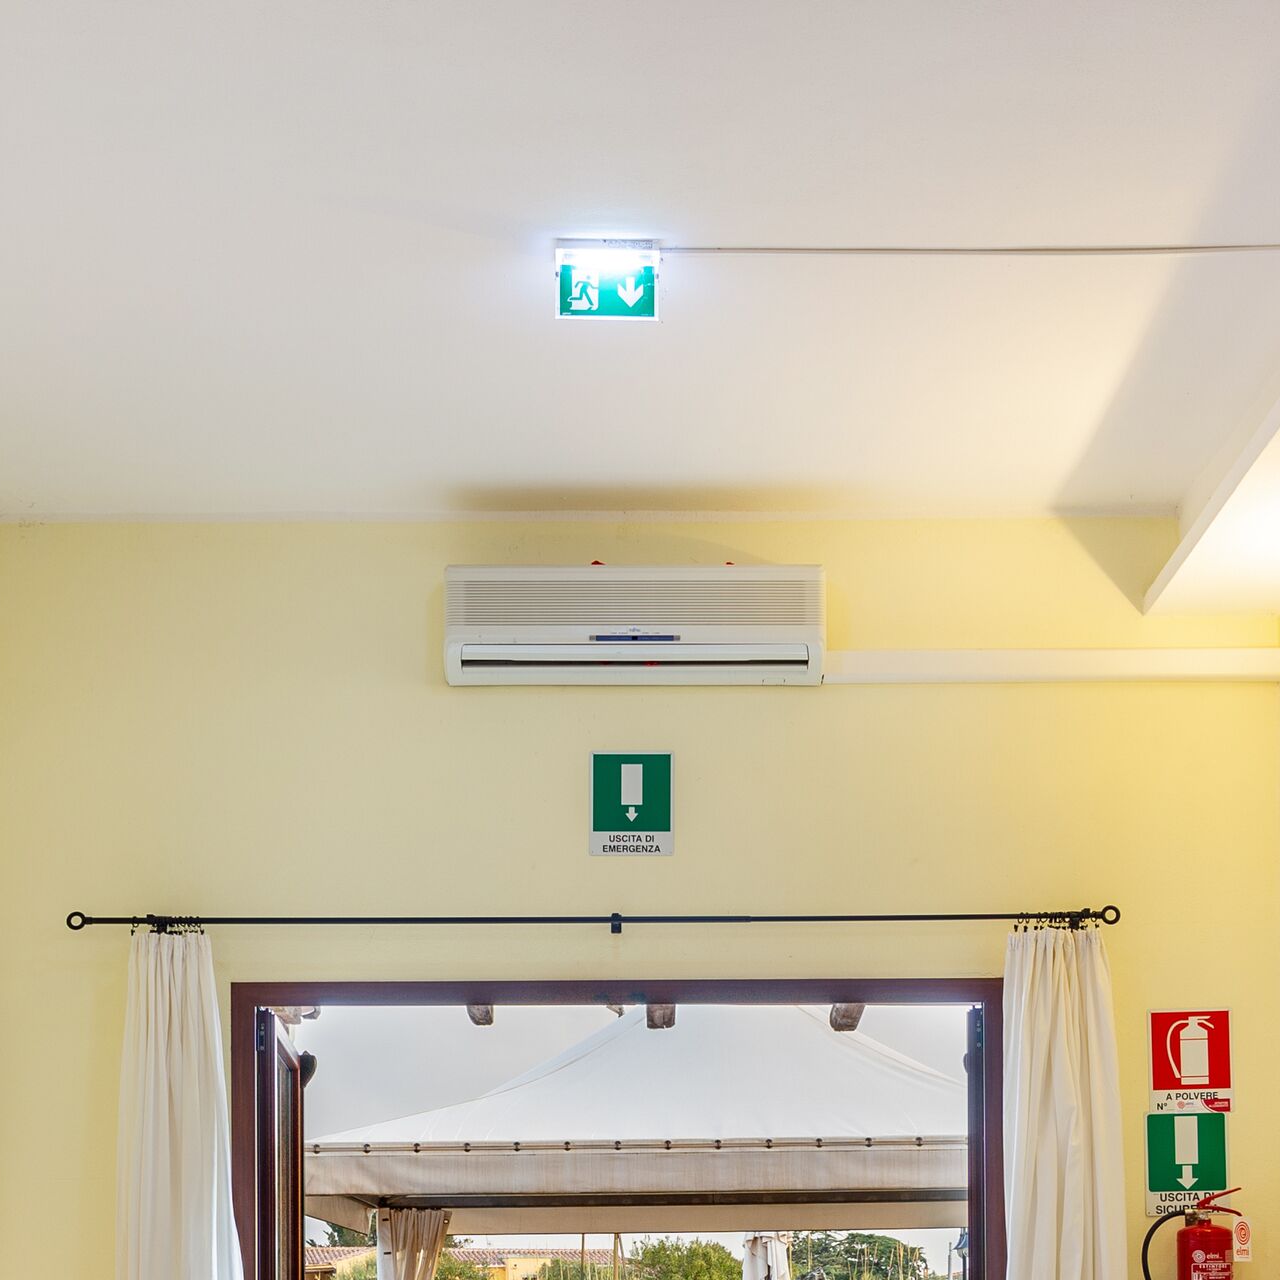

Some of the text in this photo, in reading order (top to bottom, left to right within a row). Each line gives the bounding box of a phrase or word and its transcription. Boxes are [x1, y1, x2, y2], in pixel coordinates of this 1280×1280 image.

[608, 834, 655, 842] USCITA DI
[602, 845, 661, 853] EMERGENZA
[1175, 1092, 1218, 1100] POLVERE
[1159, 1192, 1200, 1202] USCITA
